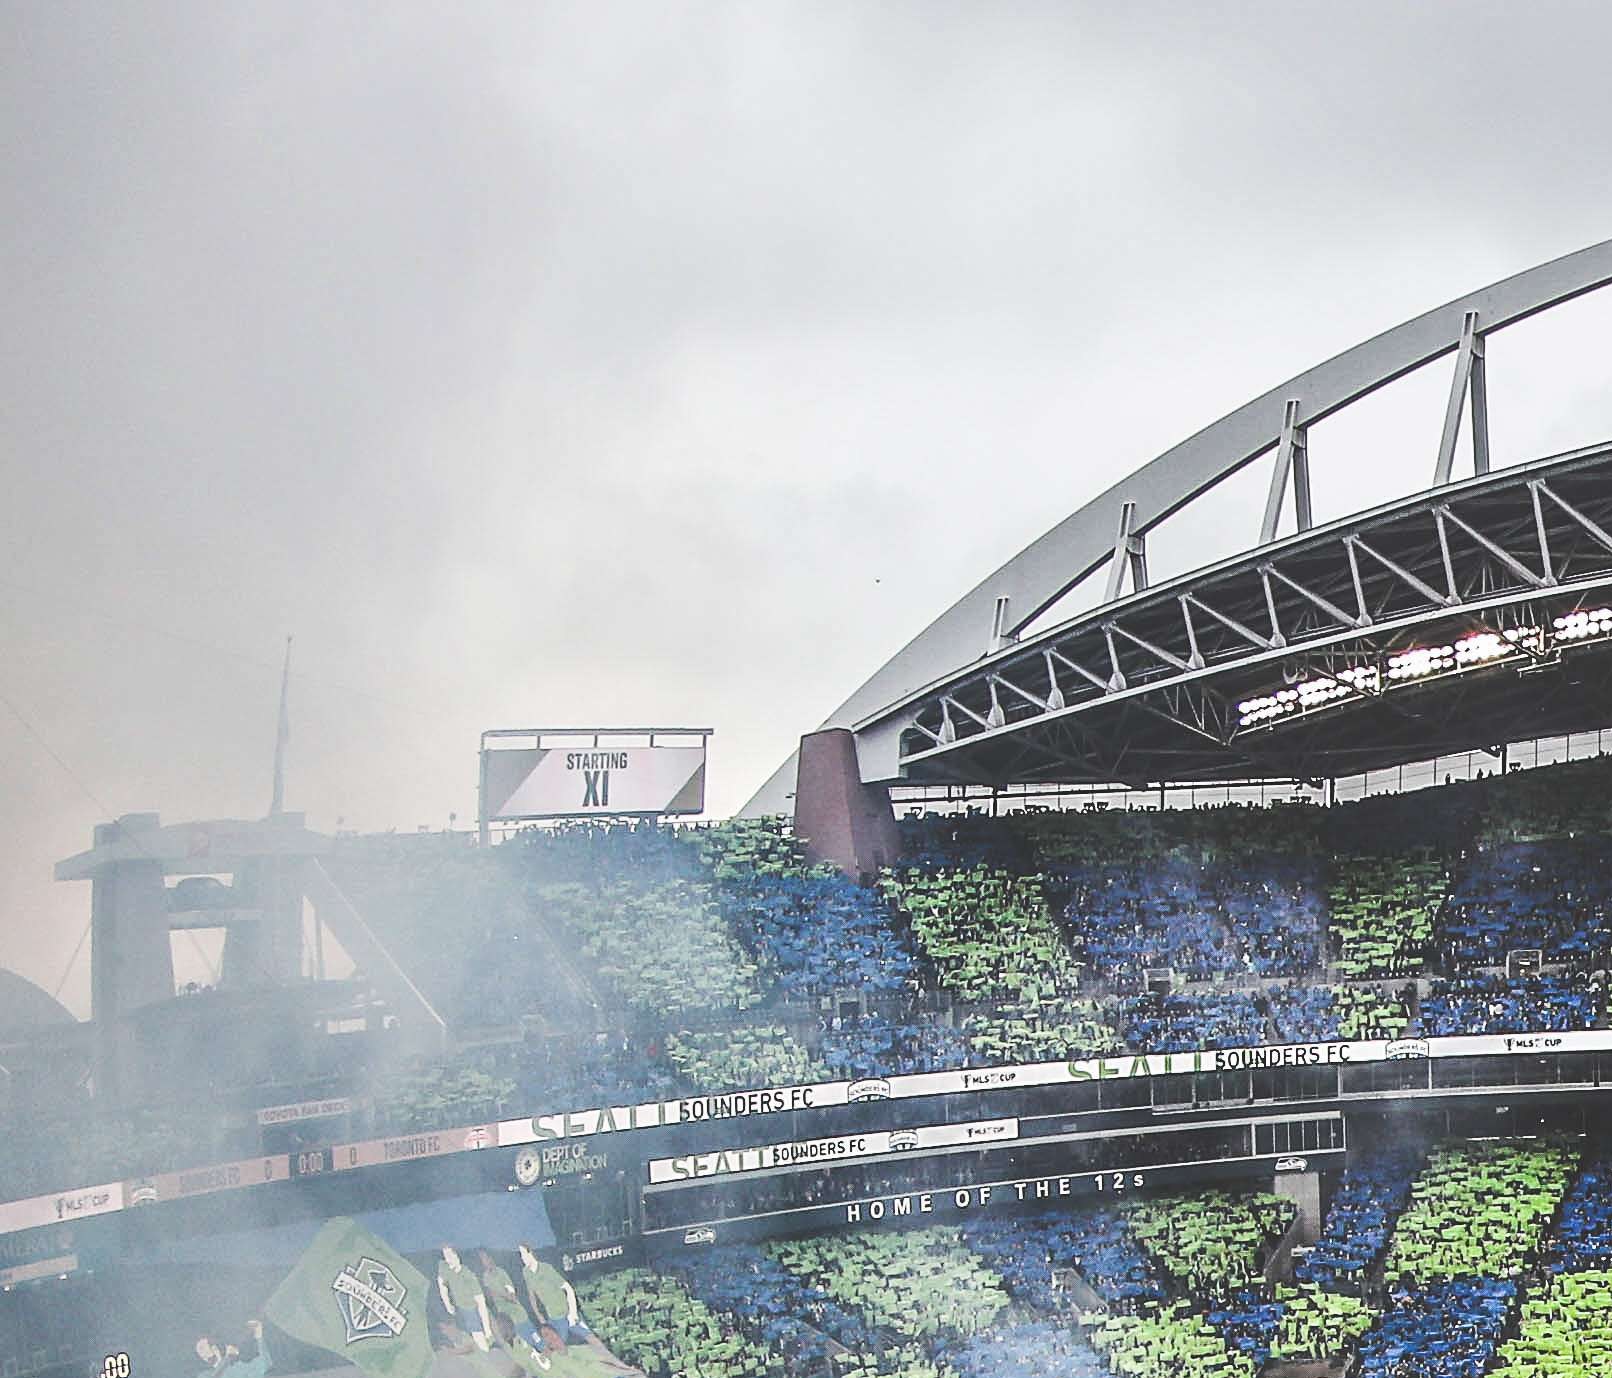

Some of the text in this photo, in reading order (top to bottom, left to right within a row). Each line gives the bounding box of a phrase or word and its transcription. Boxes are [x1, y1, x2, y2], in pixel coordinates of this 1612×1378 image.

[566, 752, 628, 771] STARTING
[583, 770, 610, 807] XI
[1544, 1038, 1562, 1047] CUP
[1215, 1043, 1351, 1070] SOUNDERS FC
[973, 1072, 1016, 1085] MLS CUP
[680, 1088, 814, 1122] SOUNDERS FC
[383, 1136, 441, 1160] TORONTO FC
[543, 1143, 588, 1165] DEPT OF
[772, 1138, 867, 1164] SOUNDERS FC
[847, 1171, 1145, 1223] HOME OF THE 12s
[575, 1245, 625, 1265] STARBUCKS
